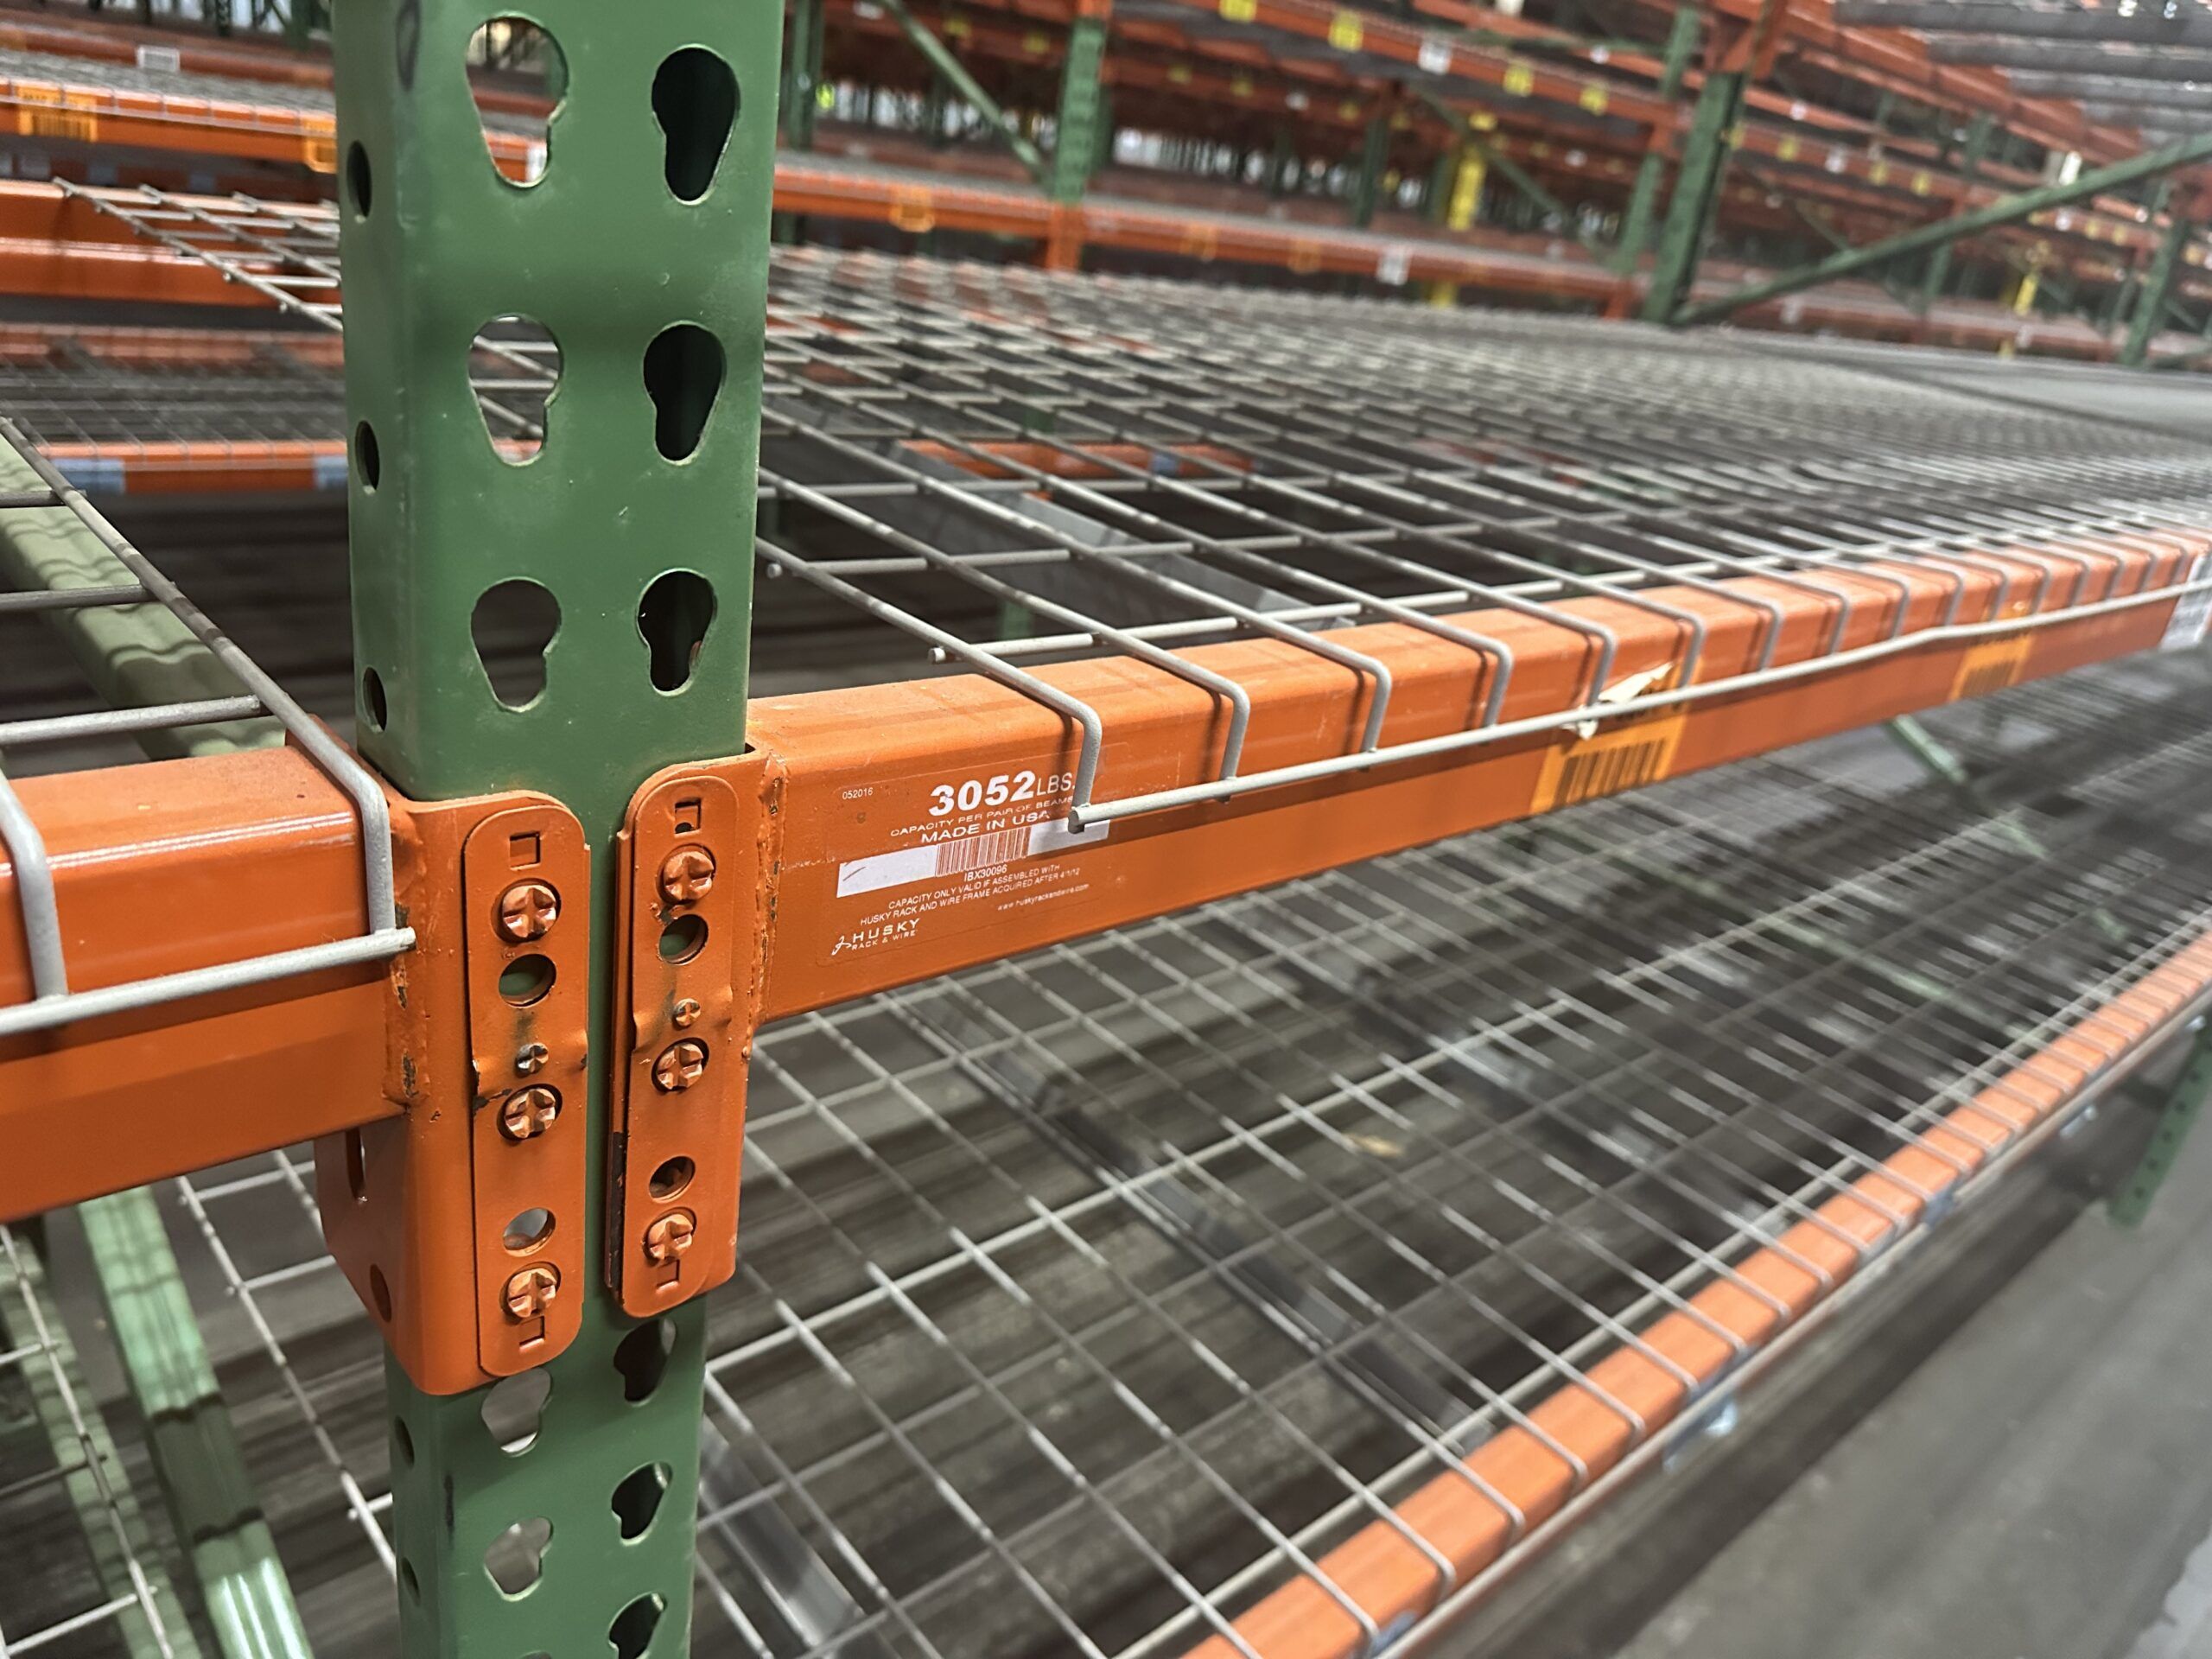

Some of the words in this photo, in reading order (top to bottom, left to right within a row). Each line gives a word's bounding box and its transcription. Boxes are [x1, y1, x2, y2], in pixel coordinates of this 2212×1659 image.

[842, 787, 873, 799] 052016
[929, 770, 1036, 817] 3052
[1037, 772, 1075, 796] LBS.
[890, 819, 954, 836] CAPACITY
[958, 814, 982, 823] PER
[987, 809, 1014, 818] PAIR
[1015, 804, 1032, 813] OF
[1036, 796, 1073, 809] BEAMS
[921, 823, 980, 843] MADE
[987, 818, 1005, 830] IN
[1012, 810, 1050, 825] USA
[888, 893, 932, 909] CAPACITY
[934, 887, 957, 899] ONLY
[958, 881, 982, 893] VALID
[983, 879, 990, 887] IF
[992, 868, 1039, 885] ASSEMBLED
[1041, 864, 1060, 874] WITH
[963, 864, 1007, 881] IBX30096
[861, 912, 892, 925] HUSKY
[893, 906, 917, 918] RACK
[919, 901, 938, 912] AND
[939, 895, 960, 907] WIRE
[963, 888, 990, 900] FRAME
[992, 880, 1033, 894] ACQUIRED
[1034, 873, 1058, 884] AFTER
[997, 883, 1089, 911] wwwhuskyrackandwire.com
[851, 939, 879, 950] RACK
[893, 930, 916, 940] WIRE
[852, 918, 919, 943] HUSKY
